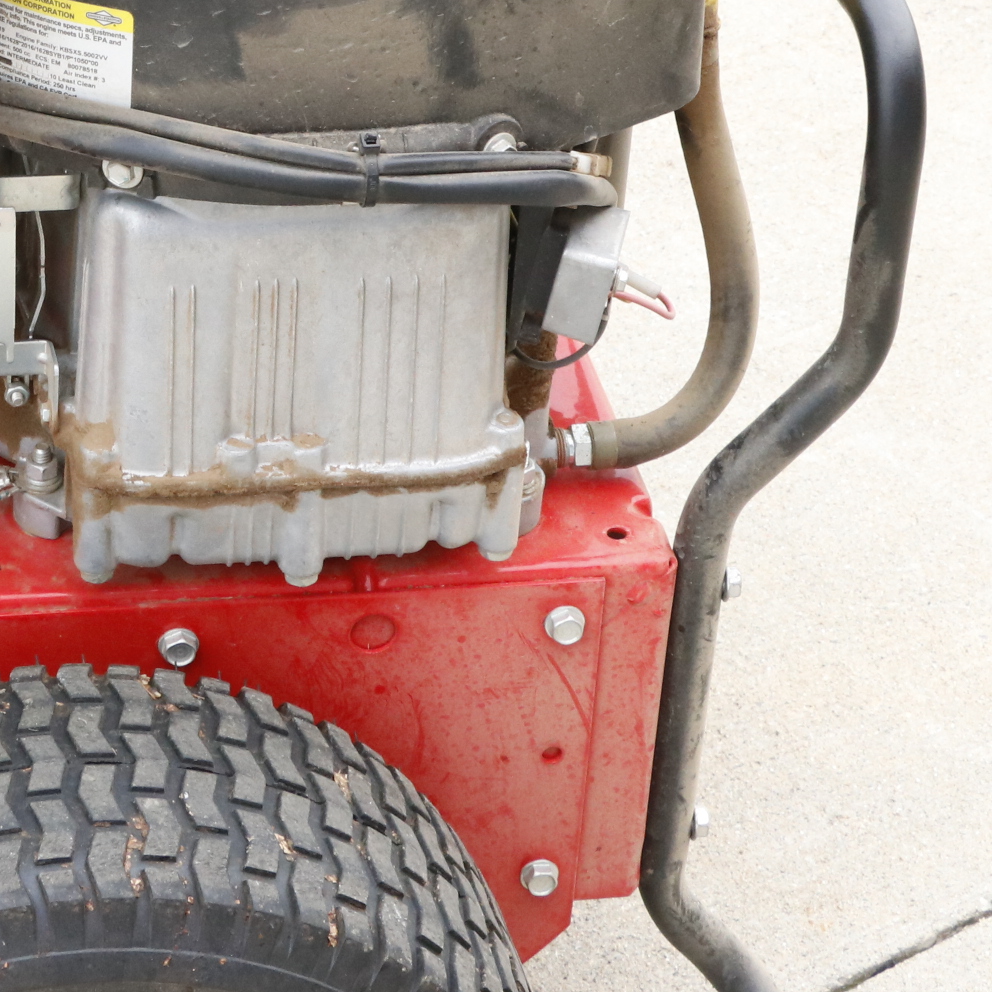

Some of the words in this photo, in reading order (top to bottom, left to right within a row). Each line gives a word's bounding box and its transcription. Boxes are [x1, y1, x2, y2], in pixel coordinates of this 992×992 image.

[23, 0, 75, 20] CORPORATION
[6, 18, 38, 34] regulations
[38, 28, 48, 38] for:
[10, 12, 22, 22] info.
[23, 16, 35, 26] This
[36, 22, 56, 34] engine
[58, 28, 76, 38] meets
[78, 32, 91, 41] U.S.
[93, 35, 108, 44] EPA
[15, 6, 23, 14] for
[24, 10, 62, 27] maintenance
[63, 21, 83, 33] specs,
[85, 27, 128, 41] adjustments,
[16, 32, 35, 44] Engine
[36, 40, 58, 51] Family:
[7, 50, 50, 70] INTERMEDIATE
[74, 72, 92, 81] Index
[12, 46, 22, 54] 500
[35, 54, 50, 62] ECS:
[51, 58, 60, 66] EM
[14, 76, 26, 85] EPA
[31, 74, 52, 86] Period:
[53, 82, 64, 90] 250
[58, 76, 76, 84] Least
[76, 80, 96, 89] Clean
